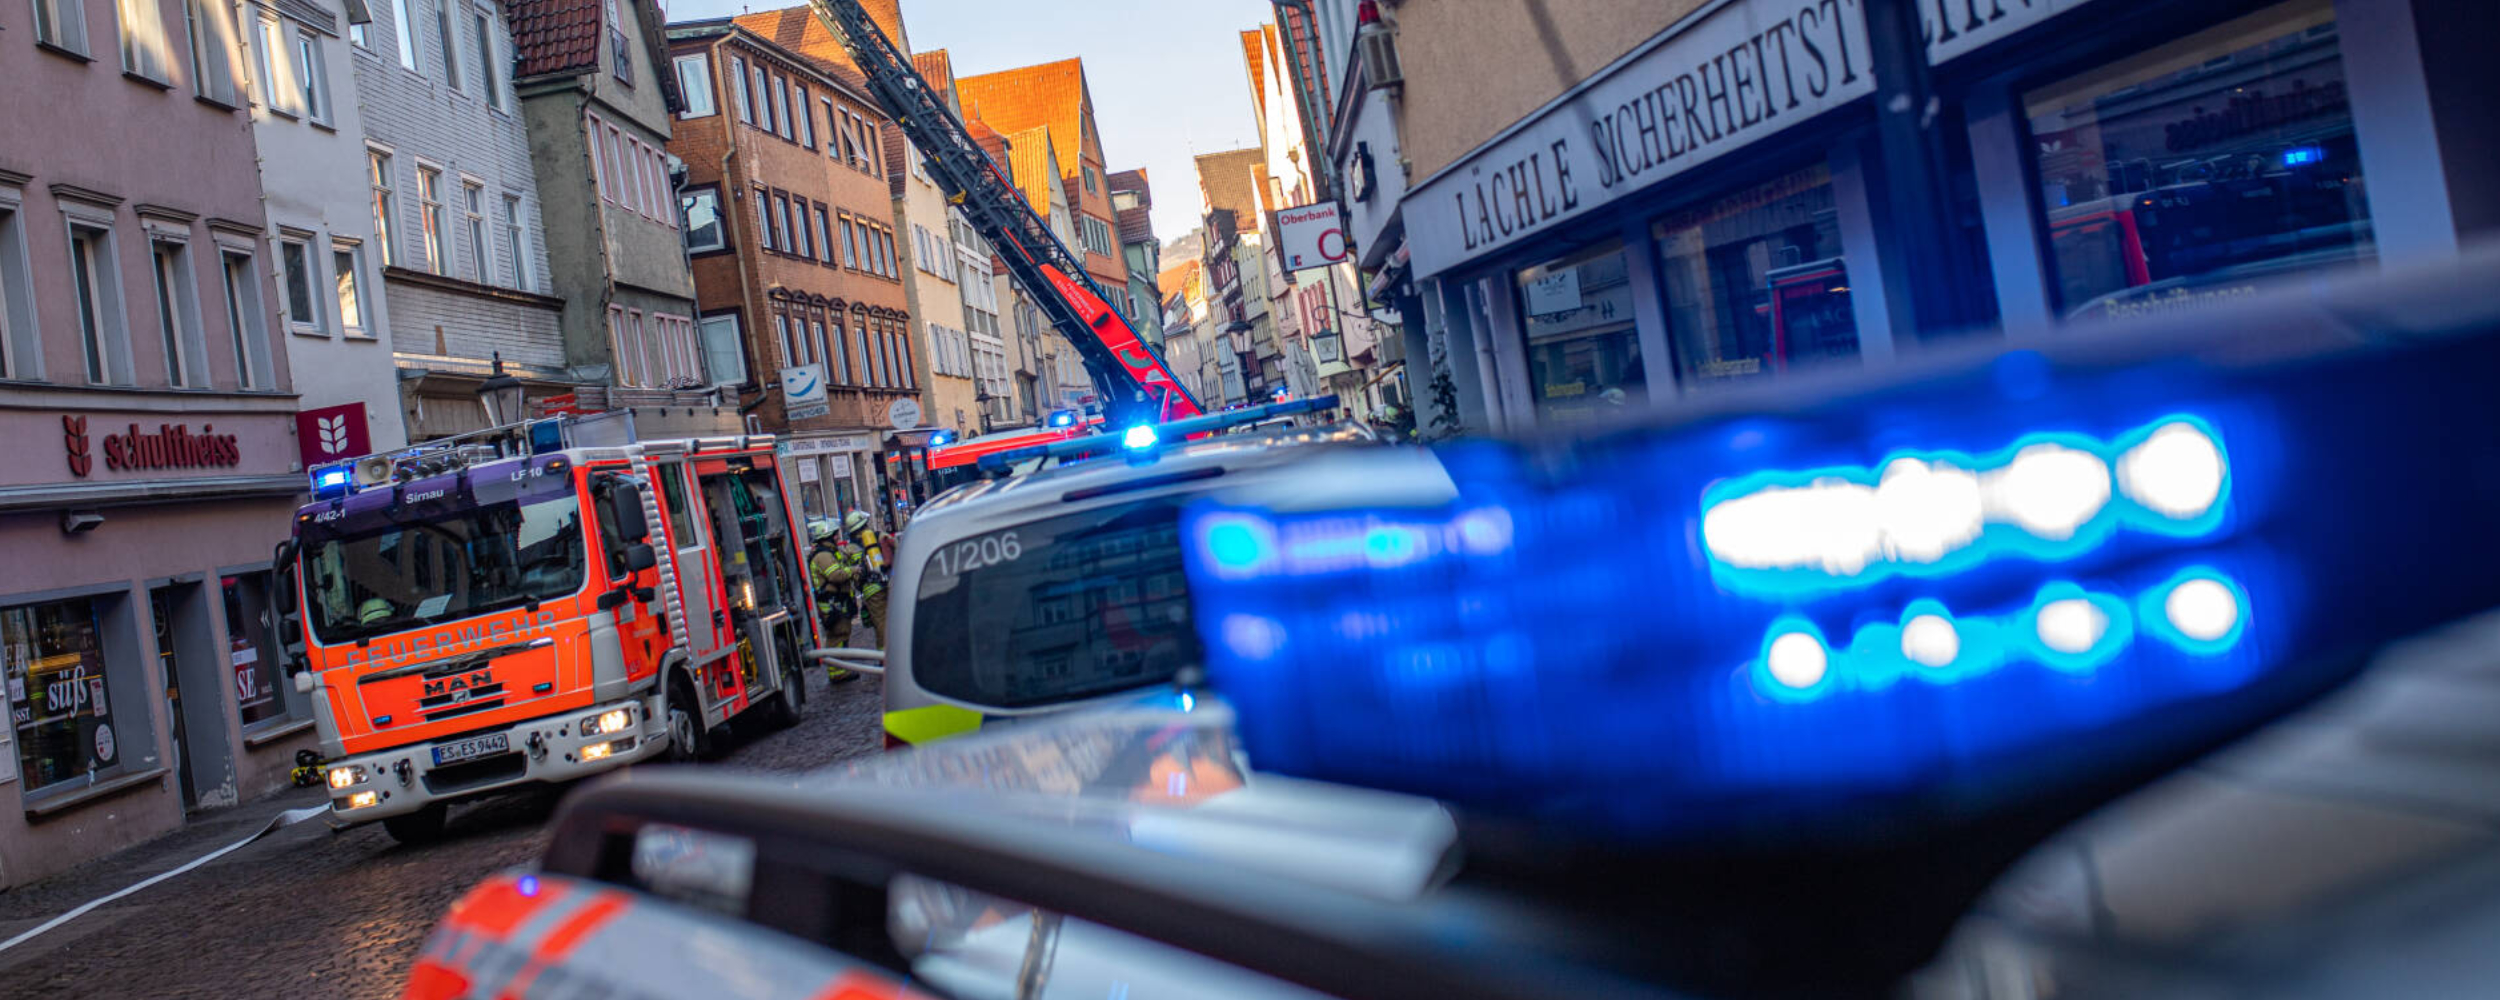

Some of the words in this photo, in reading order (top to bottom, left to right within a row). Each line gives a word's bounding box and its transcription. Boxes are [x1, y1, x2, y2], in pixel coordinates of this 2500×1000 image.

[1455, 138, 1579, 251] LÄCHLE
[1591, 0, 2028, 190] SICHERHEITST
[1281, 206, 1336, 226] Oberbank
[103, 424, 241, 470] schultheiss
[511, 470, 527, 483] LF
[529, 467, 543, 478] 10
[405, 489, 444, 504] Sirnau
[314, 510, 346, 524] 4/42-1
[935, 531, 1022, 576] 1/206
[347, 611, 556, 672] FEUERWEHR
[48, 665, 87, 718] süß
[424, 671, 492, 696] MAN
[440, 747, 455, 760] ES
[461, 743, 476, 757] ES
[477, 737, 506, 755] 9442
